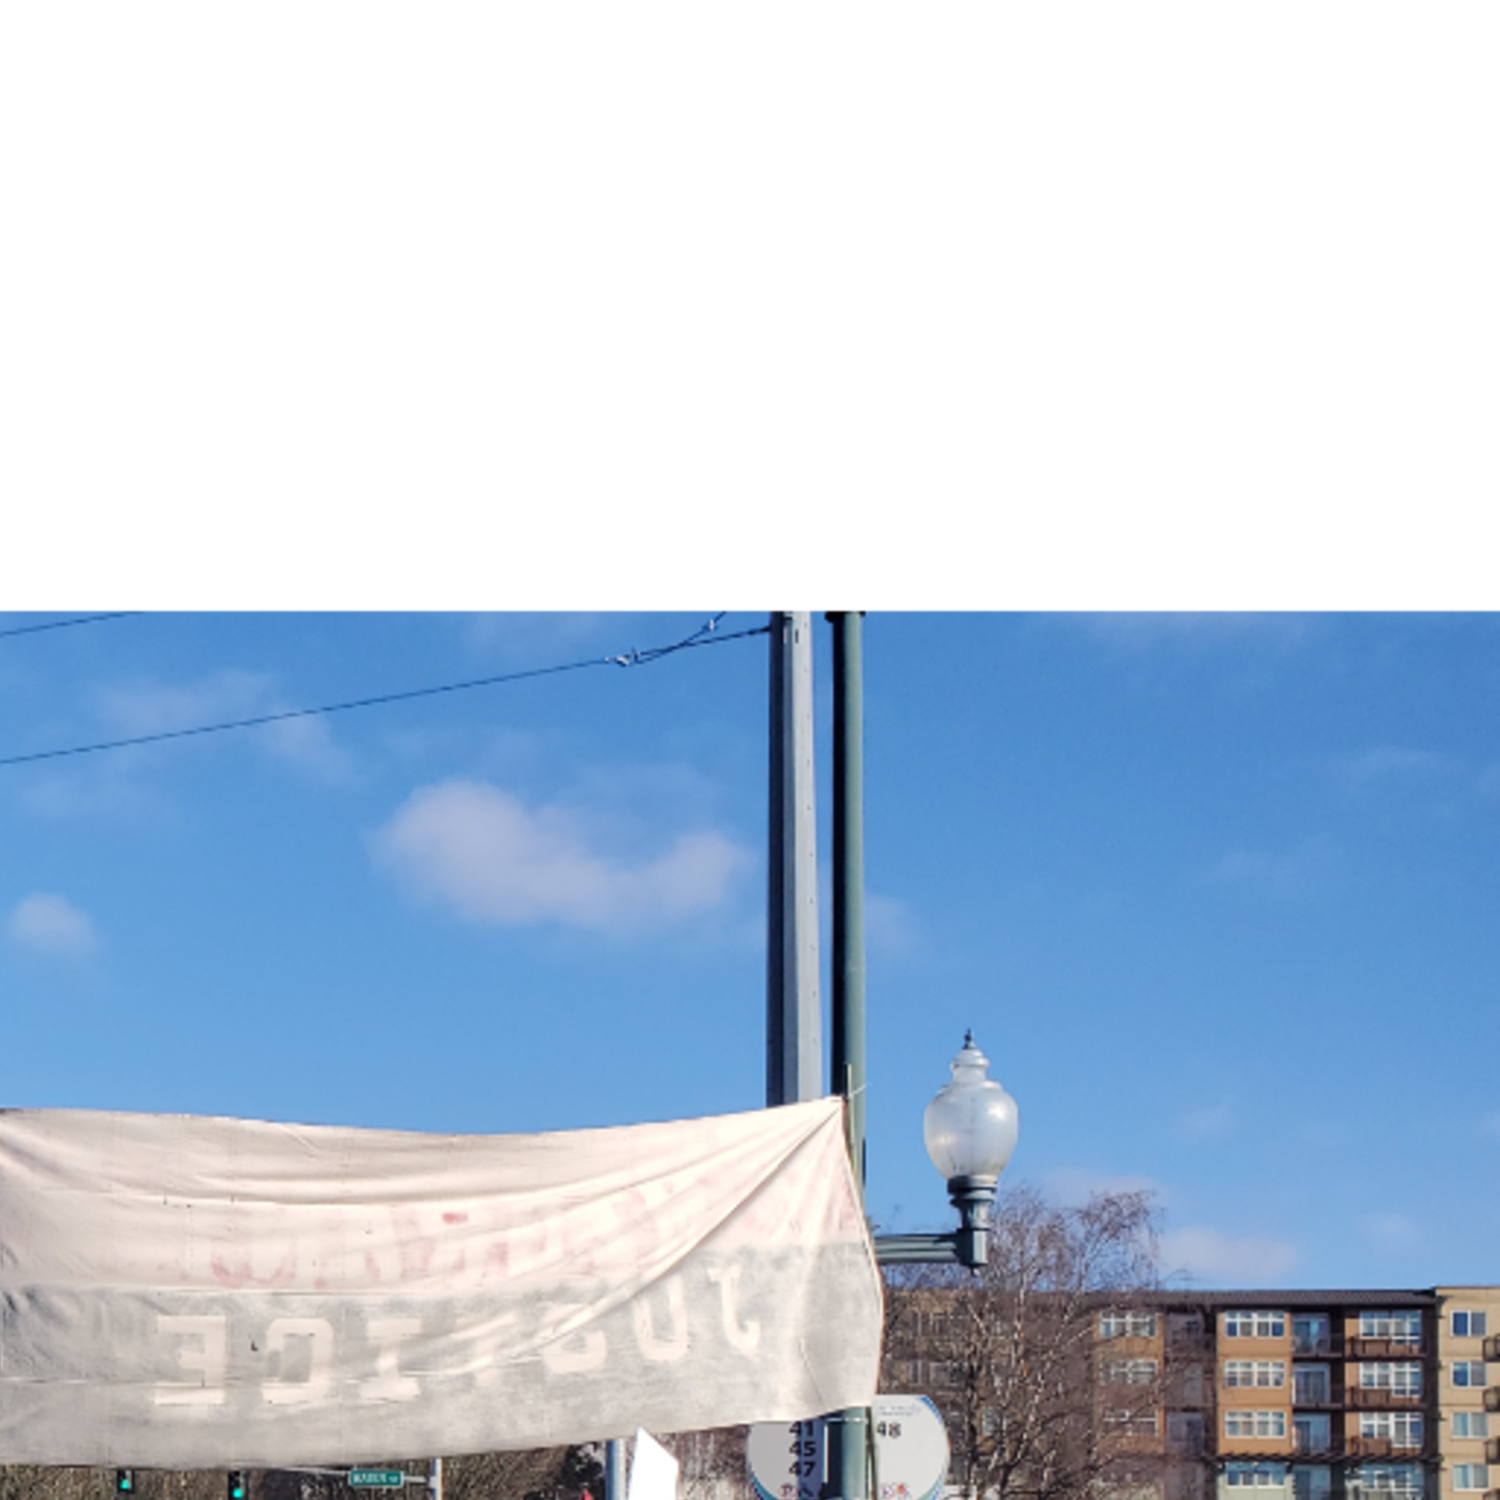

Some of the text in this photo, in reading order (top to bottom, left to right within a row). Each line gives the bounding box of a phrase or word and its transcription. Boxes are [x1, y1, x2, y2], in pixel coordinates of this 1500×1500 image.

[789, 1421, 814, 1437] 41
[876, 1421, 902, 1438] 48
[789, 1441, 816, 1457] 45
[789, 1461, 816, 1477] 47
